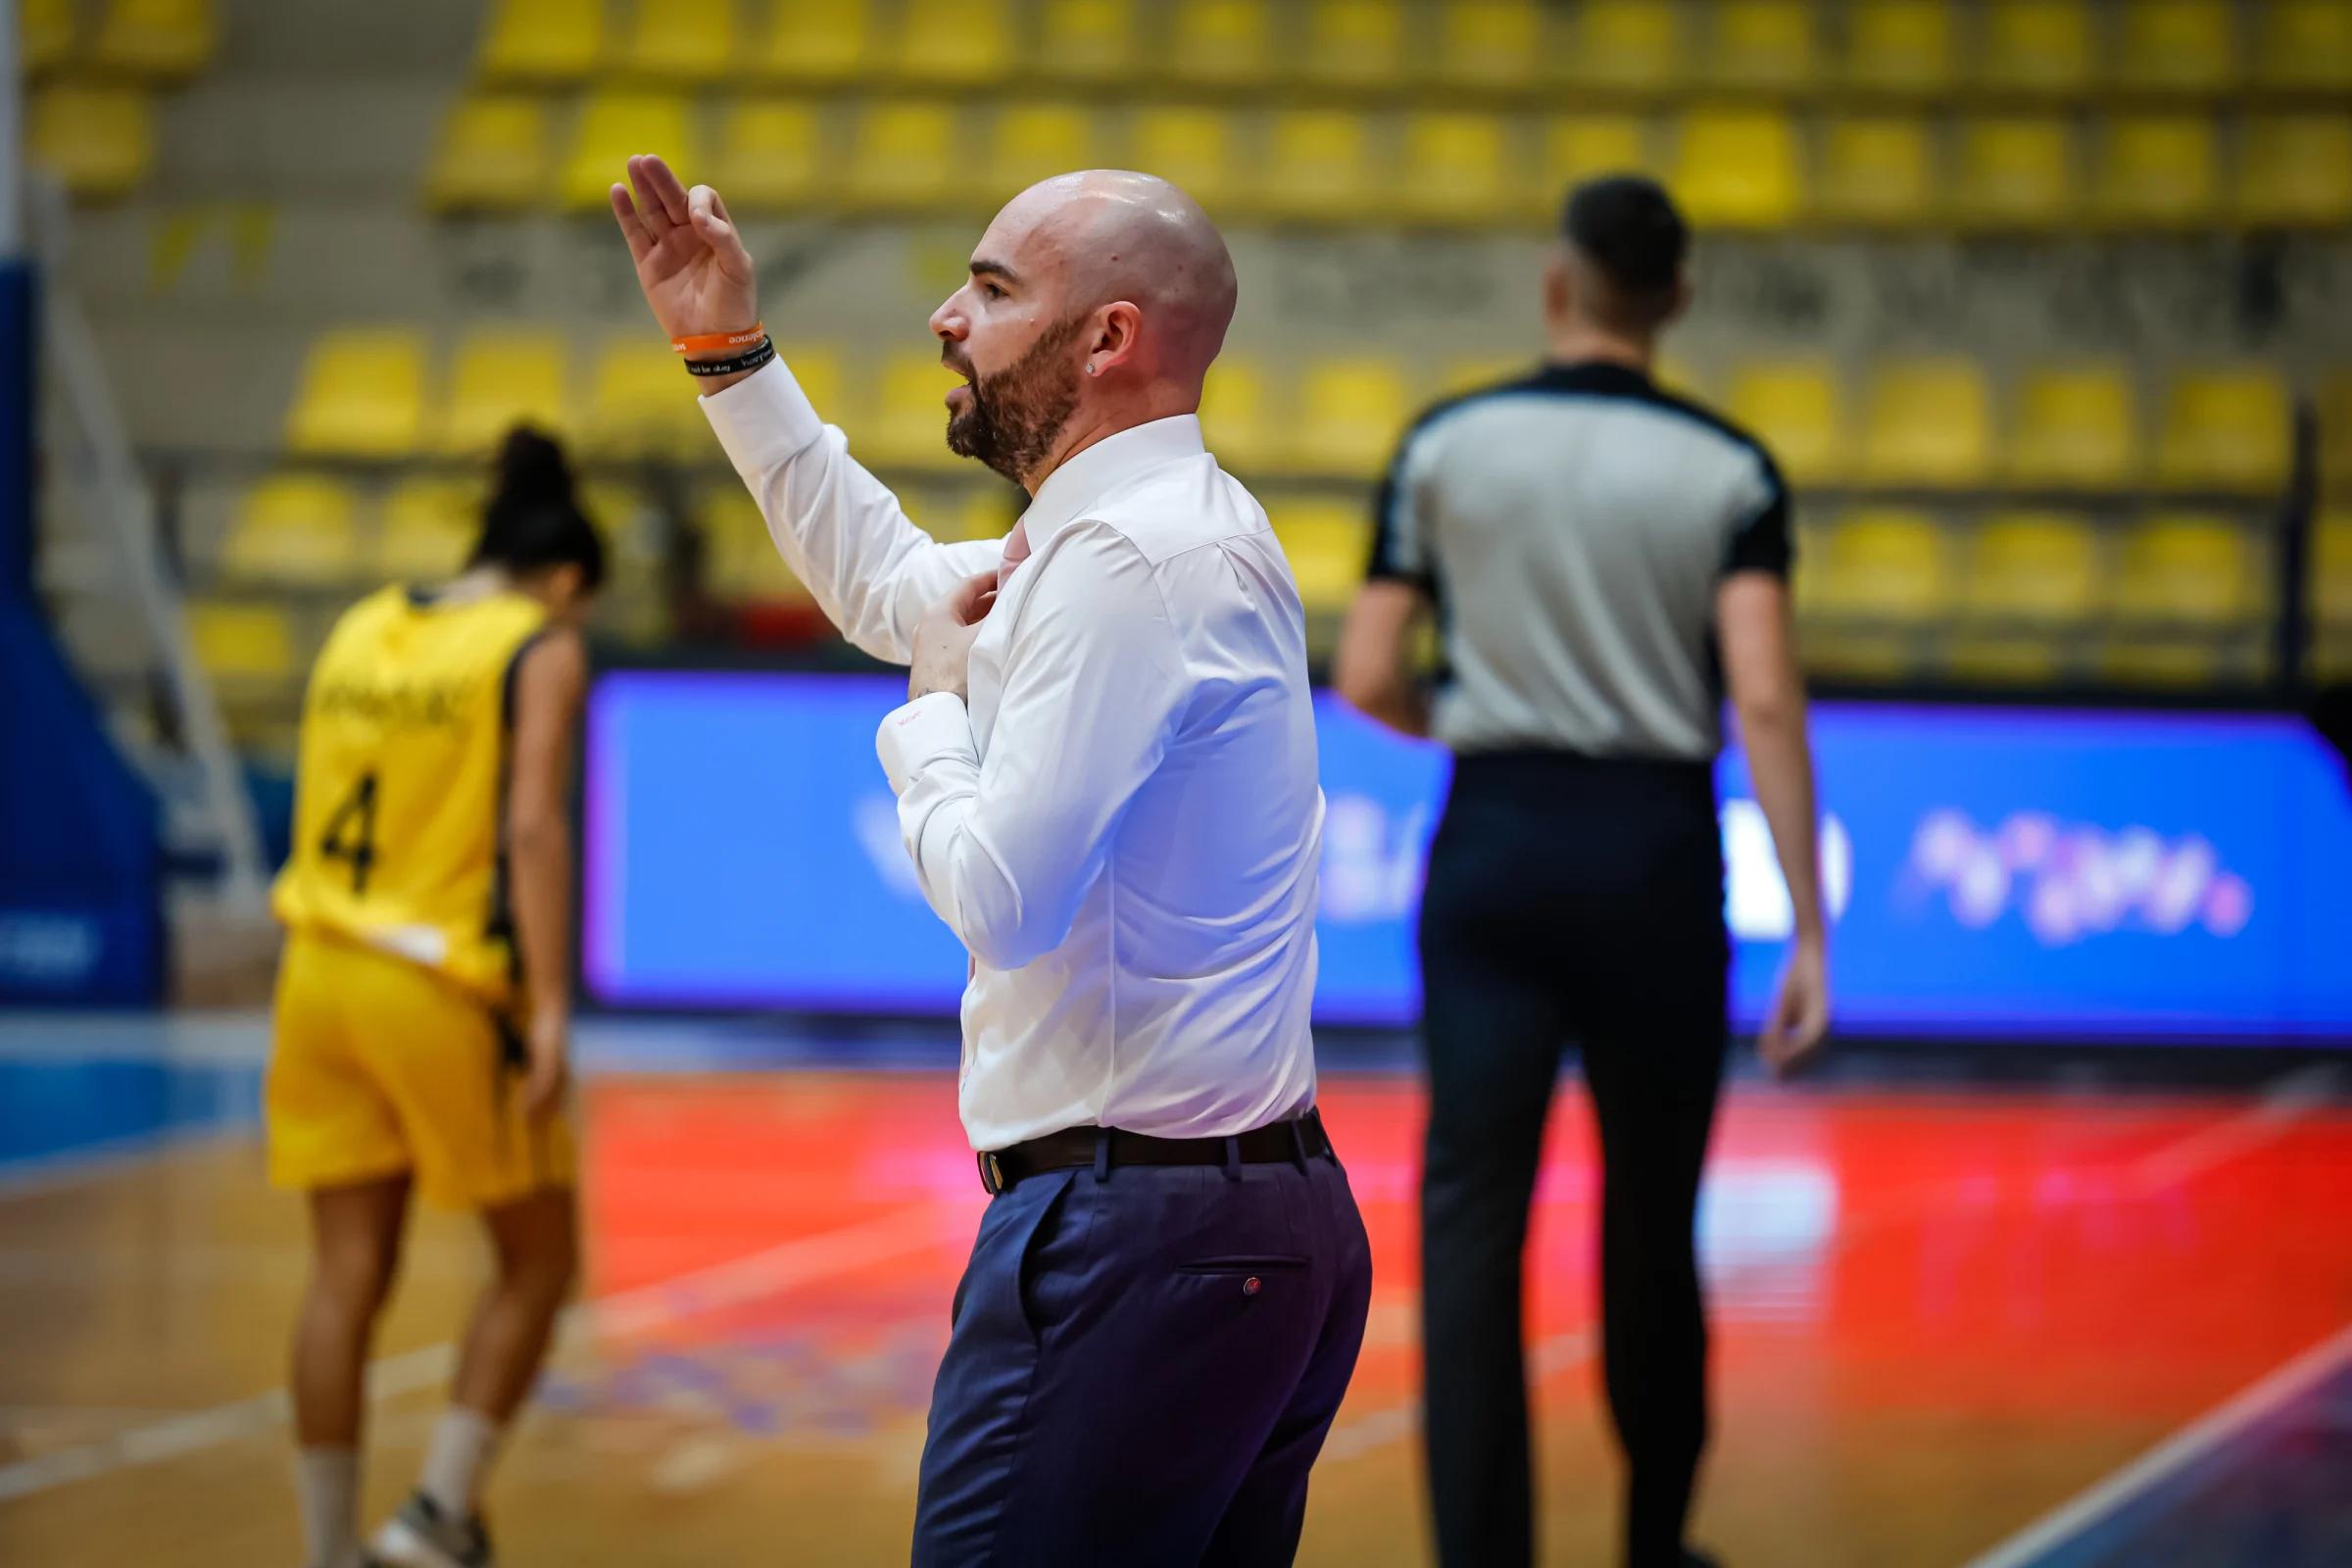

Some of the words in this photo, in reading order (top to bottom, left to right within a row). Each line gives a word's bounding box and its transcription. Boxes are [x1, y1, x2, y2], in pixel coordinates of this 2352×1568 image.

[702, 364, 710, 373] be
[712, 365, 731, 373] okay
[318, 769, 380, 896] 4
